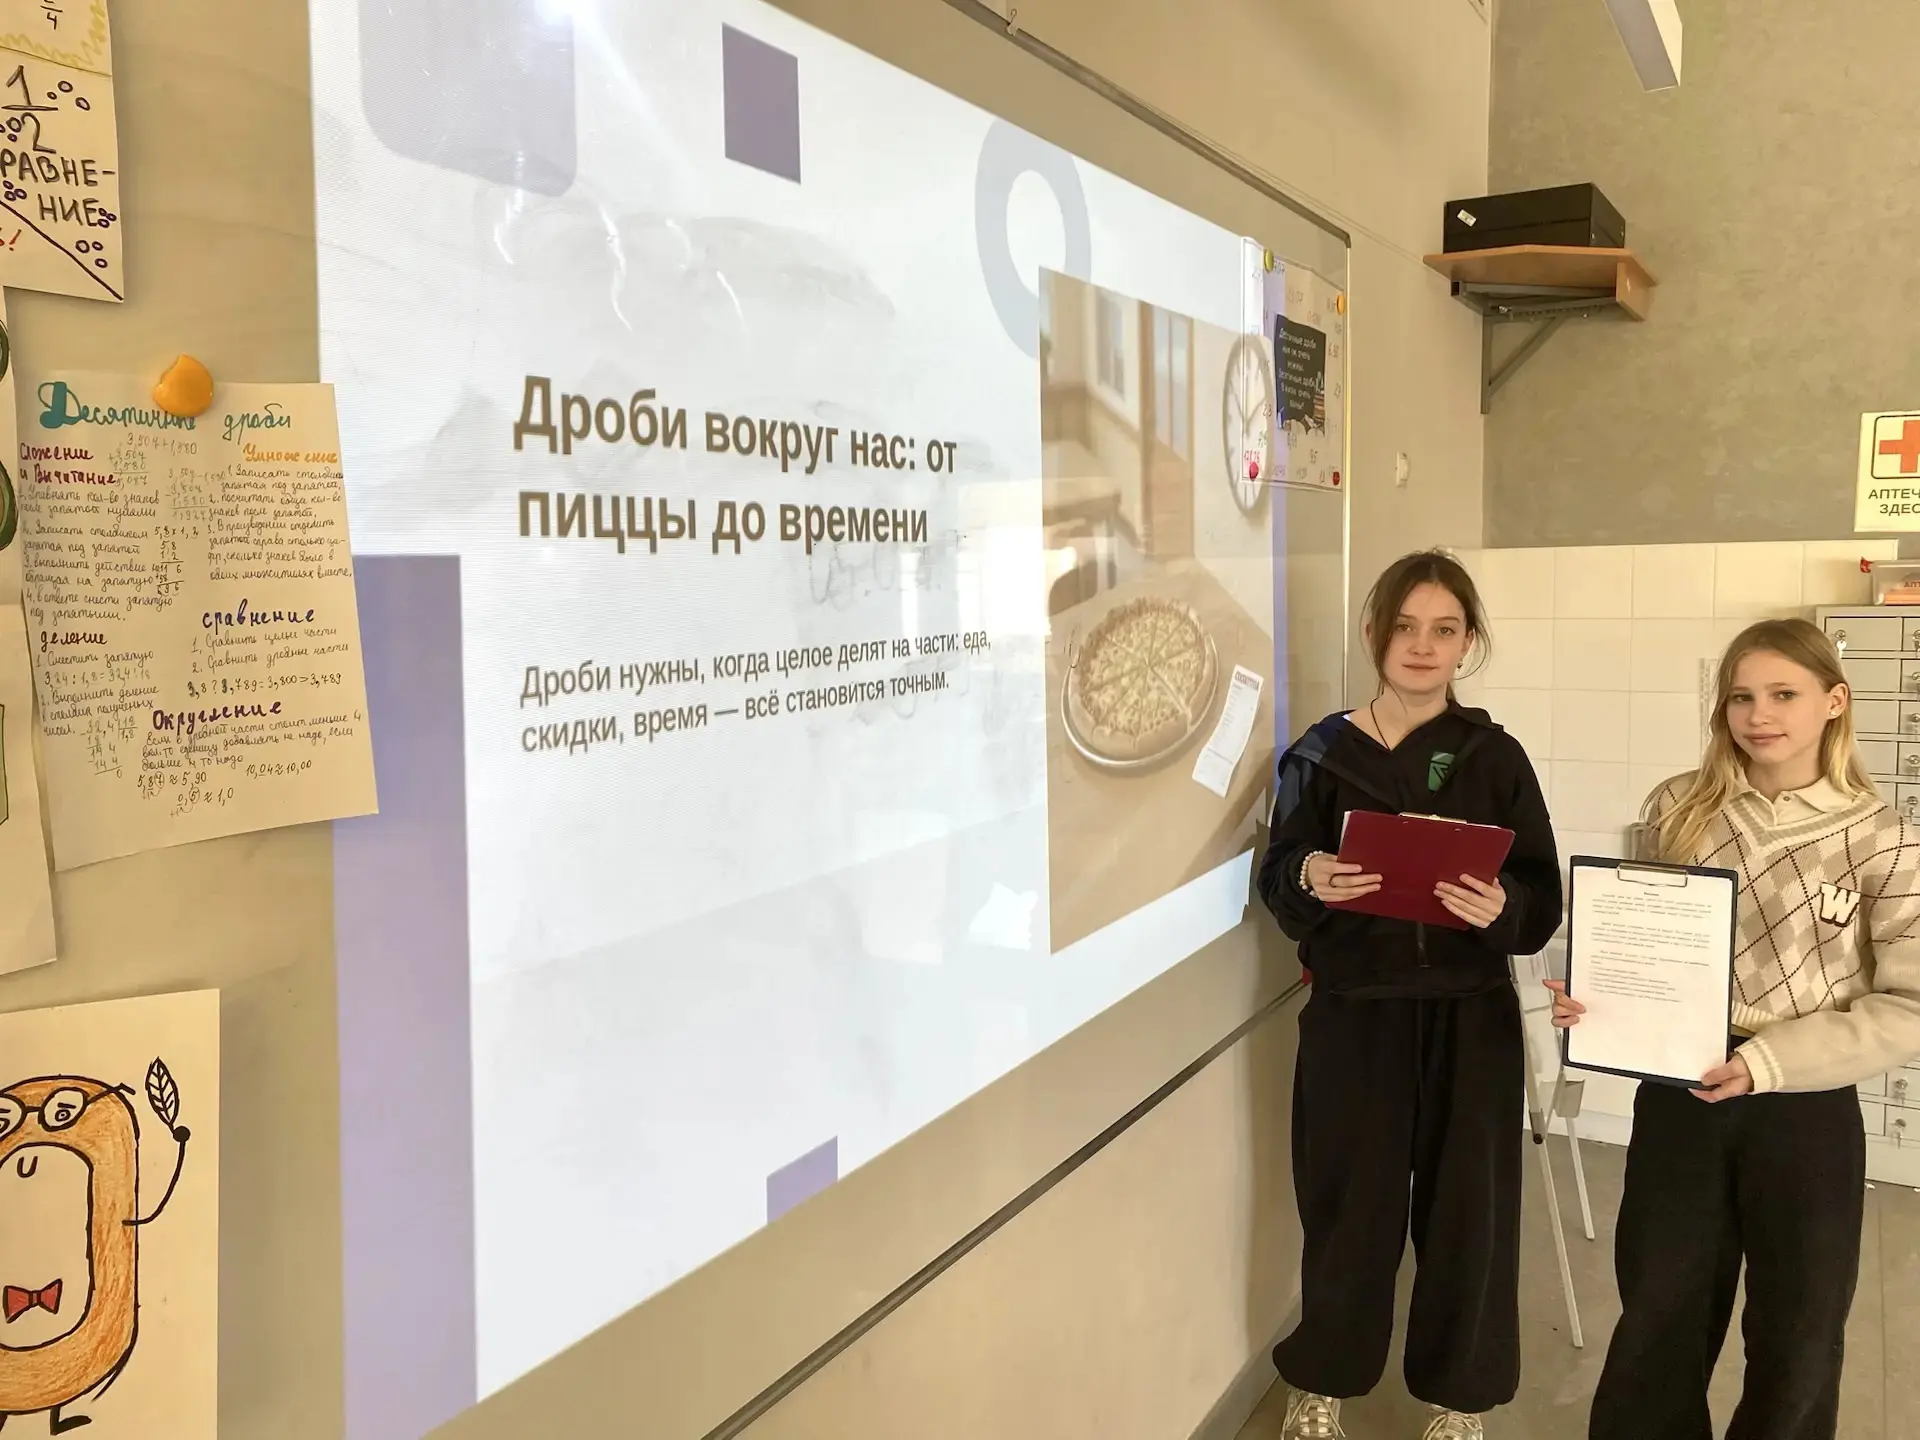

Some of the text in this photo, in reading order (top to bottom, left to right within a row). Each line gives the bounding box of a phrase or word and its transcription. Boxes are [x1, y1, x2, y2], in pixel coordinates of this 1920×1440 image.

[46, 12, 57, 30] 4
[6, 65, 32, 106] 1
[20, 112, 57, 154] 2
[38, 193, 99, 227] НИЕ
[222, 403, 291, 445] дроби
[514, 375, 957, 474] Дроби вокруг нас: от
[1868, 488, 1920, 499] АПТЕЧ
[1880, 503, 1920, 516] ЗДЕС
[519, 491, 927, 555] пиццы до времени
[202, 598, 315, 635] сравнение
[40, 630, 108, 653] деление
[520, 630, 991, 709] Дроби нужны, когда целое делят на части: еда,
[152, 701, 282, 736] Округление
[522, 716, 624, 756] скидки,
[634, 703, 708, 742] время
[746, 690, 780, 720] всё
[786, 678, 885, 713] становится
[890, 671, 950, 697] точным.
[1820, 881, 1861, 927] W
